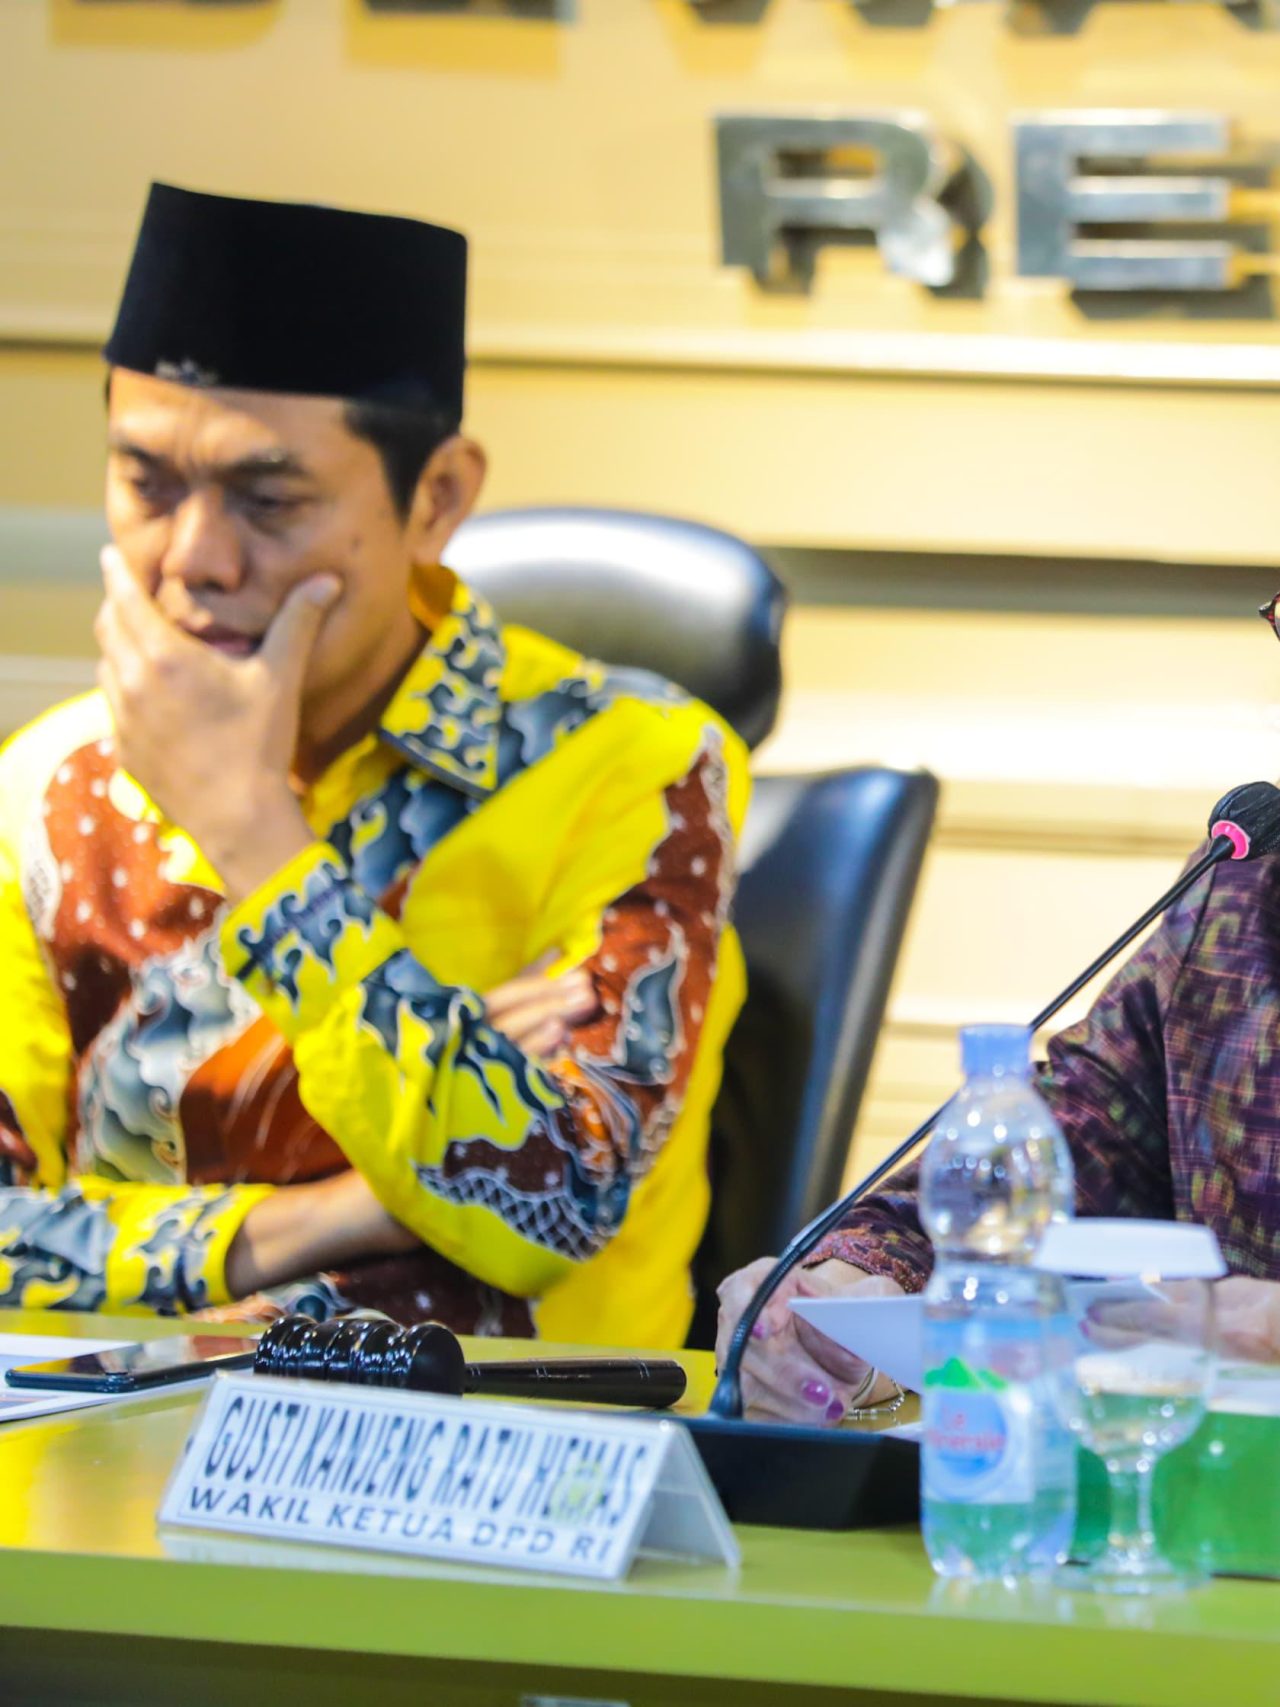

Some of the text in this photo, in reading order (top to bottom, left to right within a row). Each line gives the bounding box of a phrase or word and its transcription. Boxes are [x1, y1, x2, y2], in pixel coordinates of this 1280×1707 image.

[204, 1396, 310, 1486] GUSTI
[290, 1406, 444, 1503] KANJENG
[430, 1424, 534, 1512] RATU
[190, 1486, 612, 1561] WAKIL KETUA DPD RI
